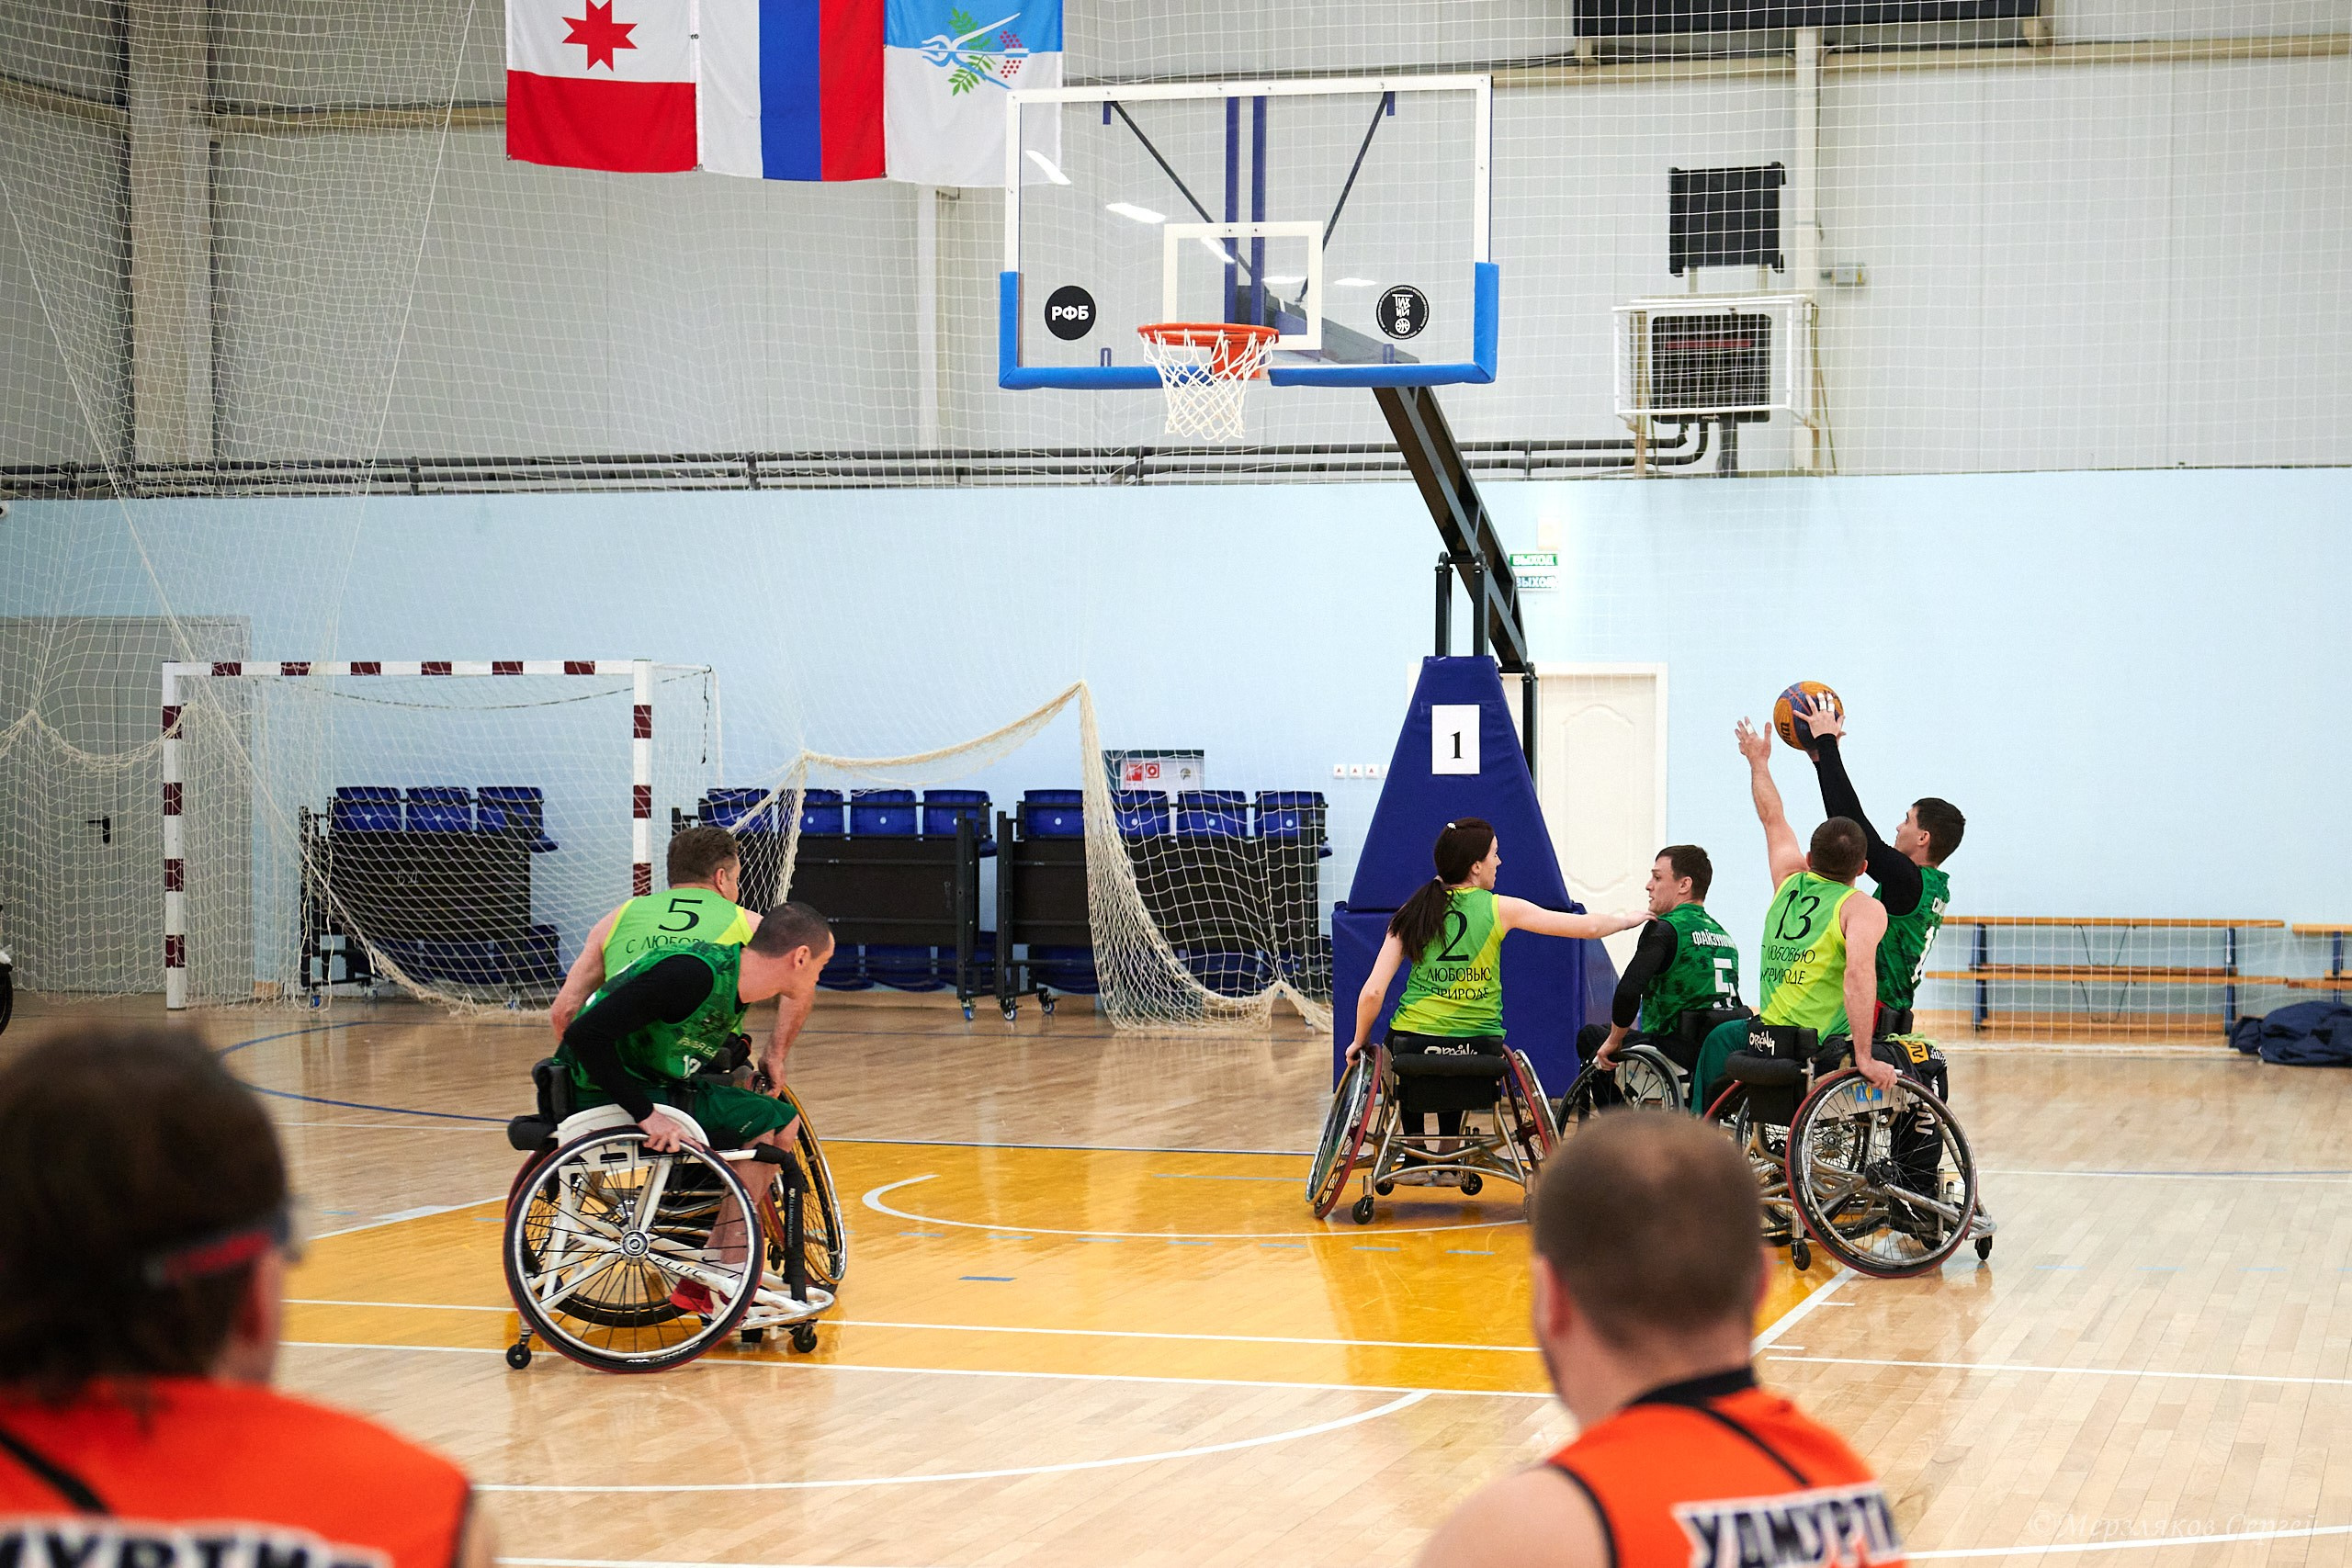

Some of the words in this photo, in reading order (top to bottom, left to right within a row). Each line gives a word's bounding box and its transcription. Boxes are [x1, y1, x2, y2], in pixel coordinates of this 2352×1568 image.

[1051, 305, 1090, 321] РФБ
[1450, 731, 1464, 760] 1
[658, 897, 703, 931] 5
[1775, 889, 1821, 941] 13
[626, 939, 637, 953] С
[1436, 909, 1468, 962] 2
[1426, 966, 1493, 983] ЛЮБОВЬЮ
